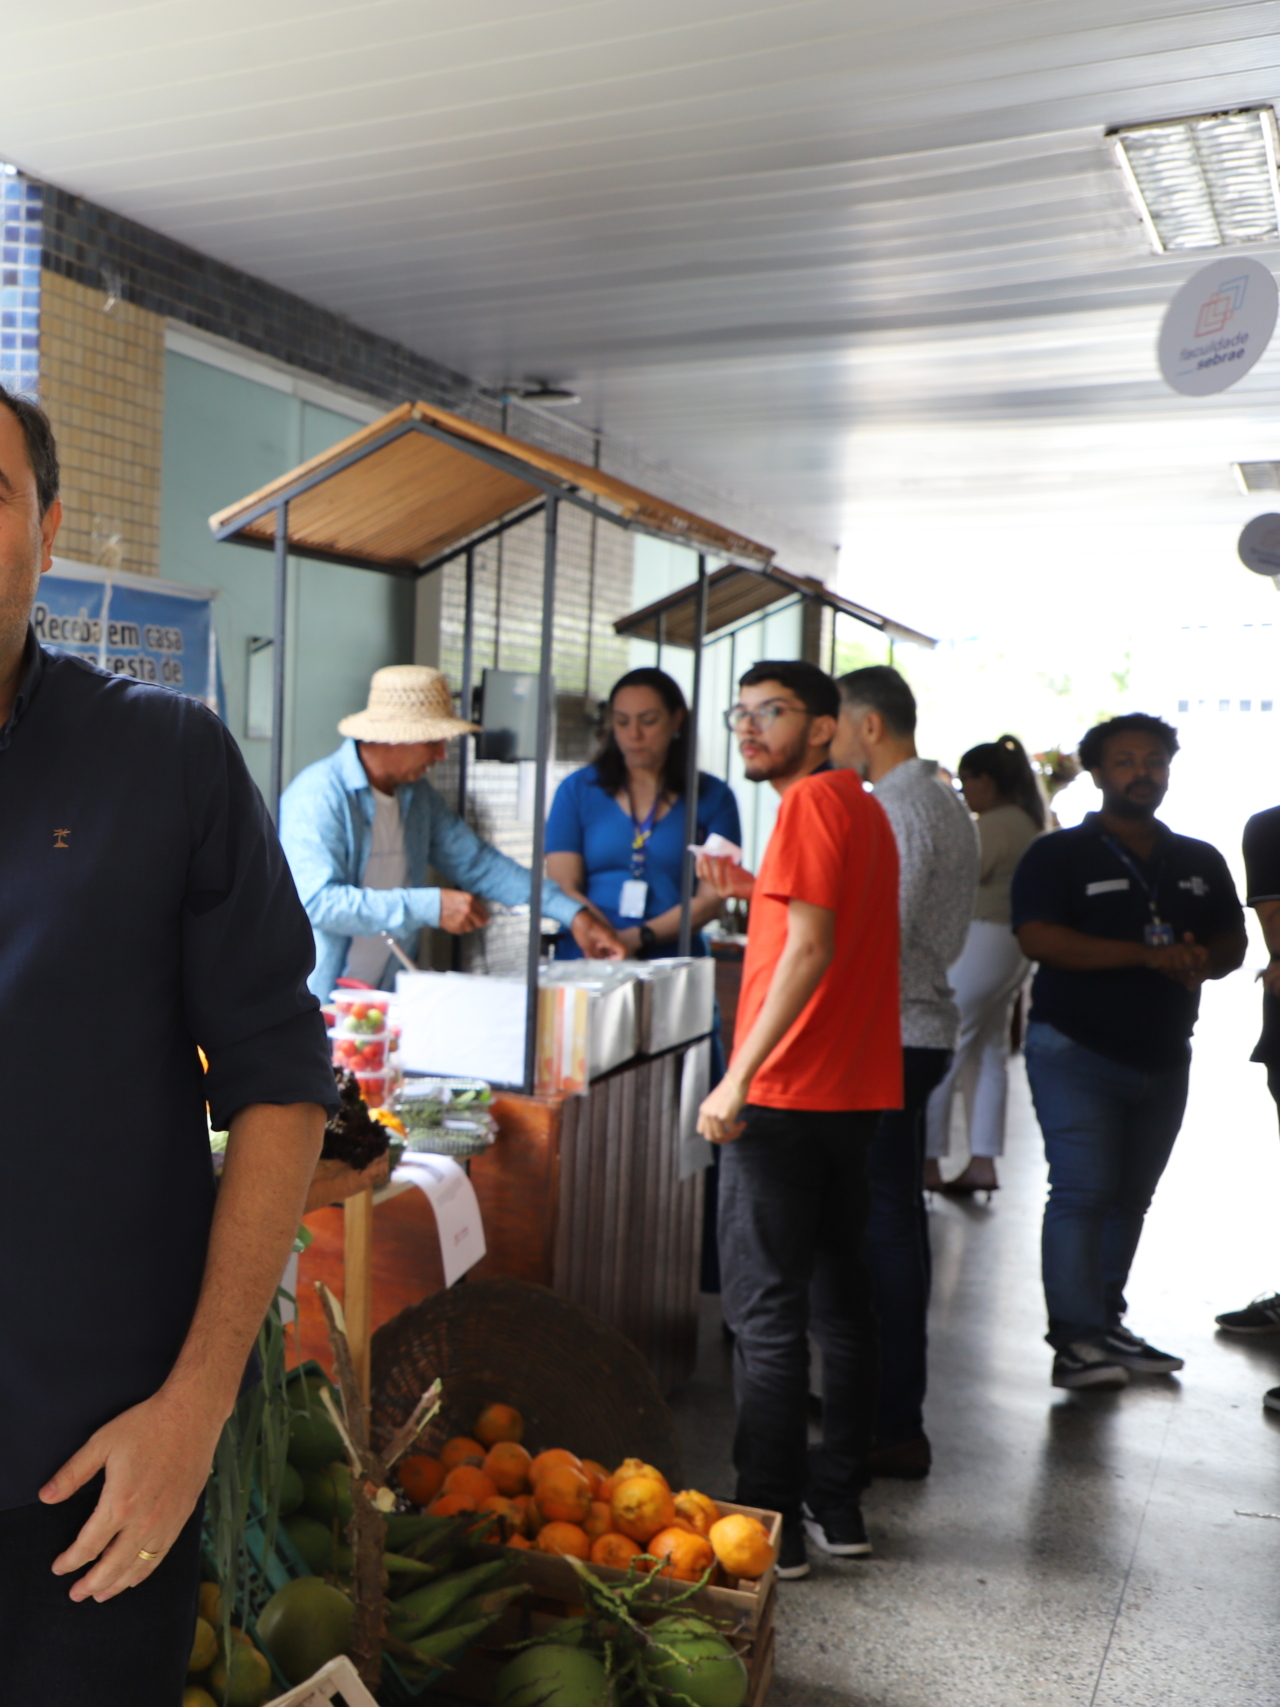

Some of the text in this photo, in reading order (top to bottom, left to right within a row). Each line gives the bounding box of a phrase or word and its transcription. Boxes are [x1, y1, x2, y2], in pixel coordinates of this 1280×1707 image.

[1179, 332, 1249, 361] faculdade
[1197, 348, 1246, 370] sebrae
[108, 623, 140, 647] em
[145, 626, 182, 650] casa
[162, 655, 182, 684] de
